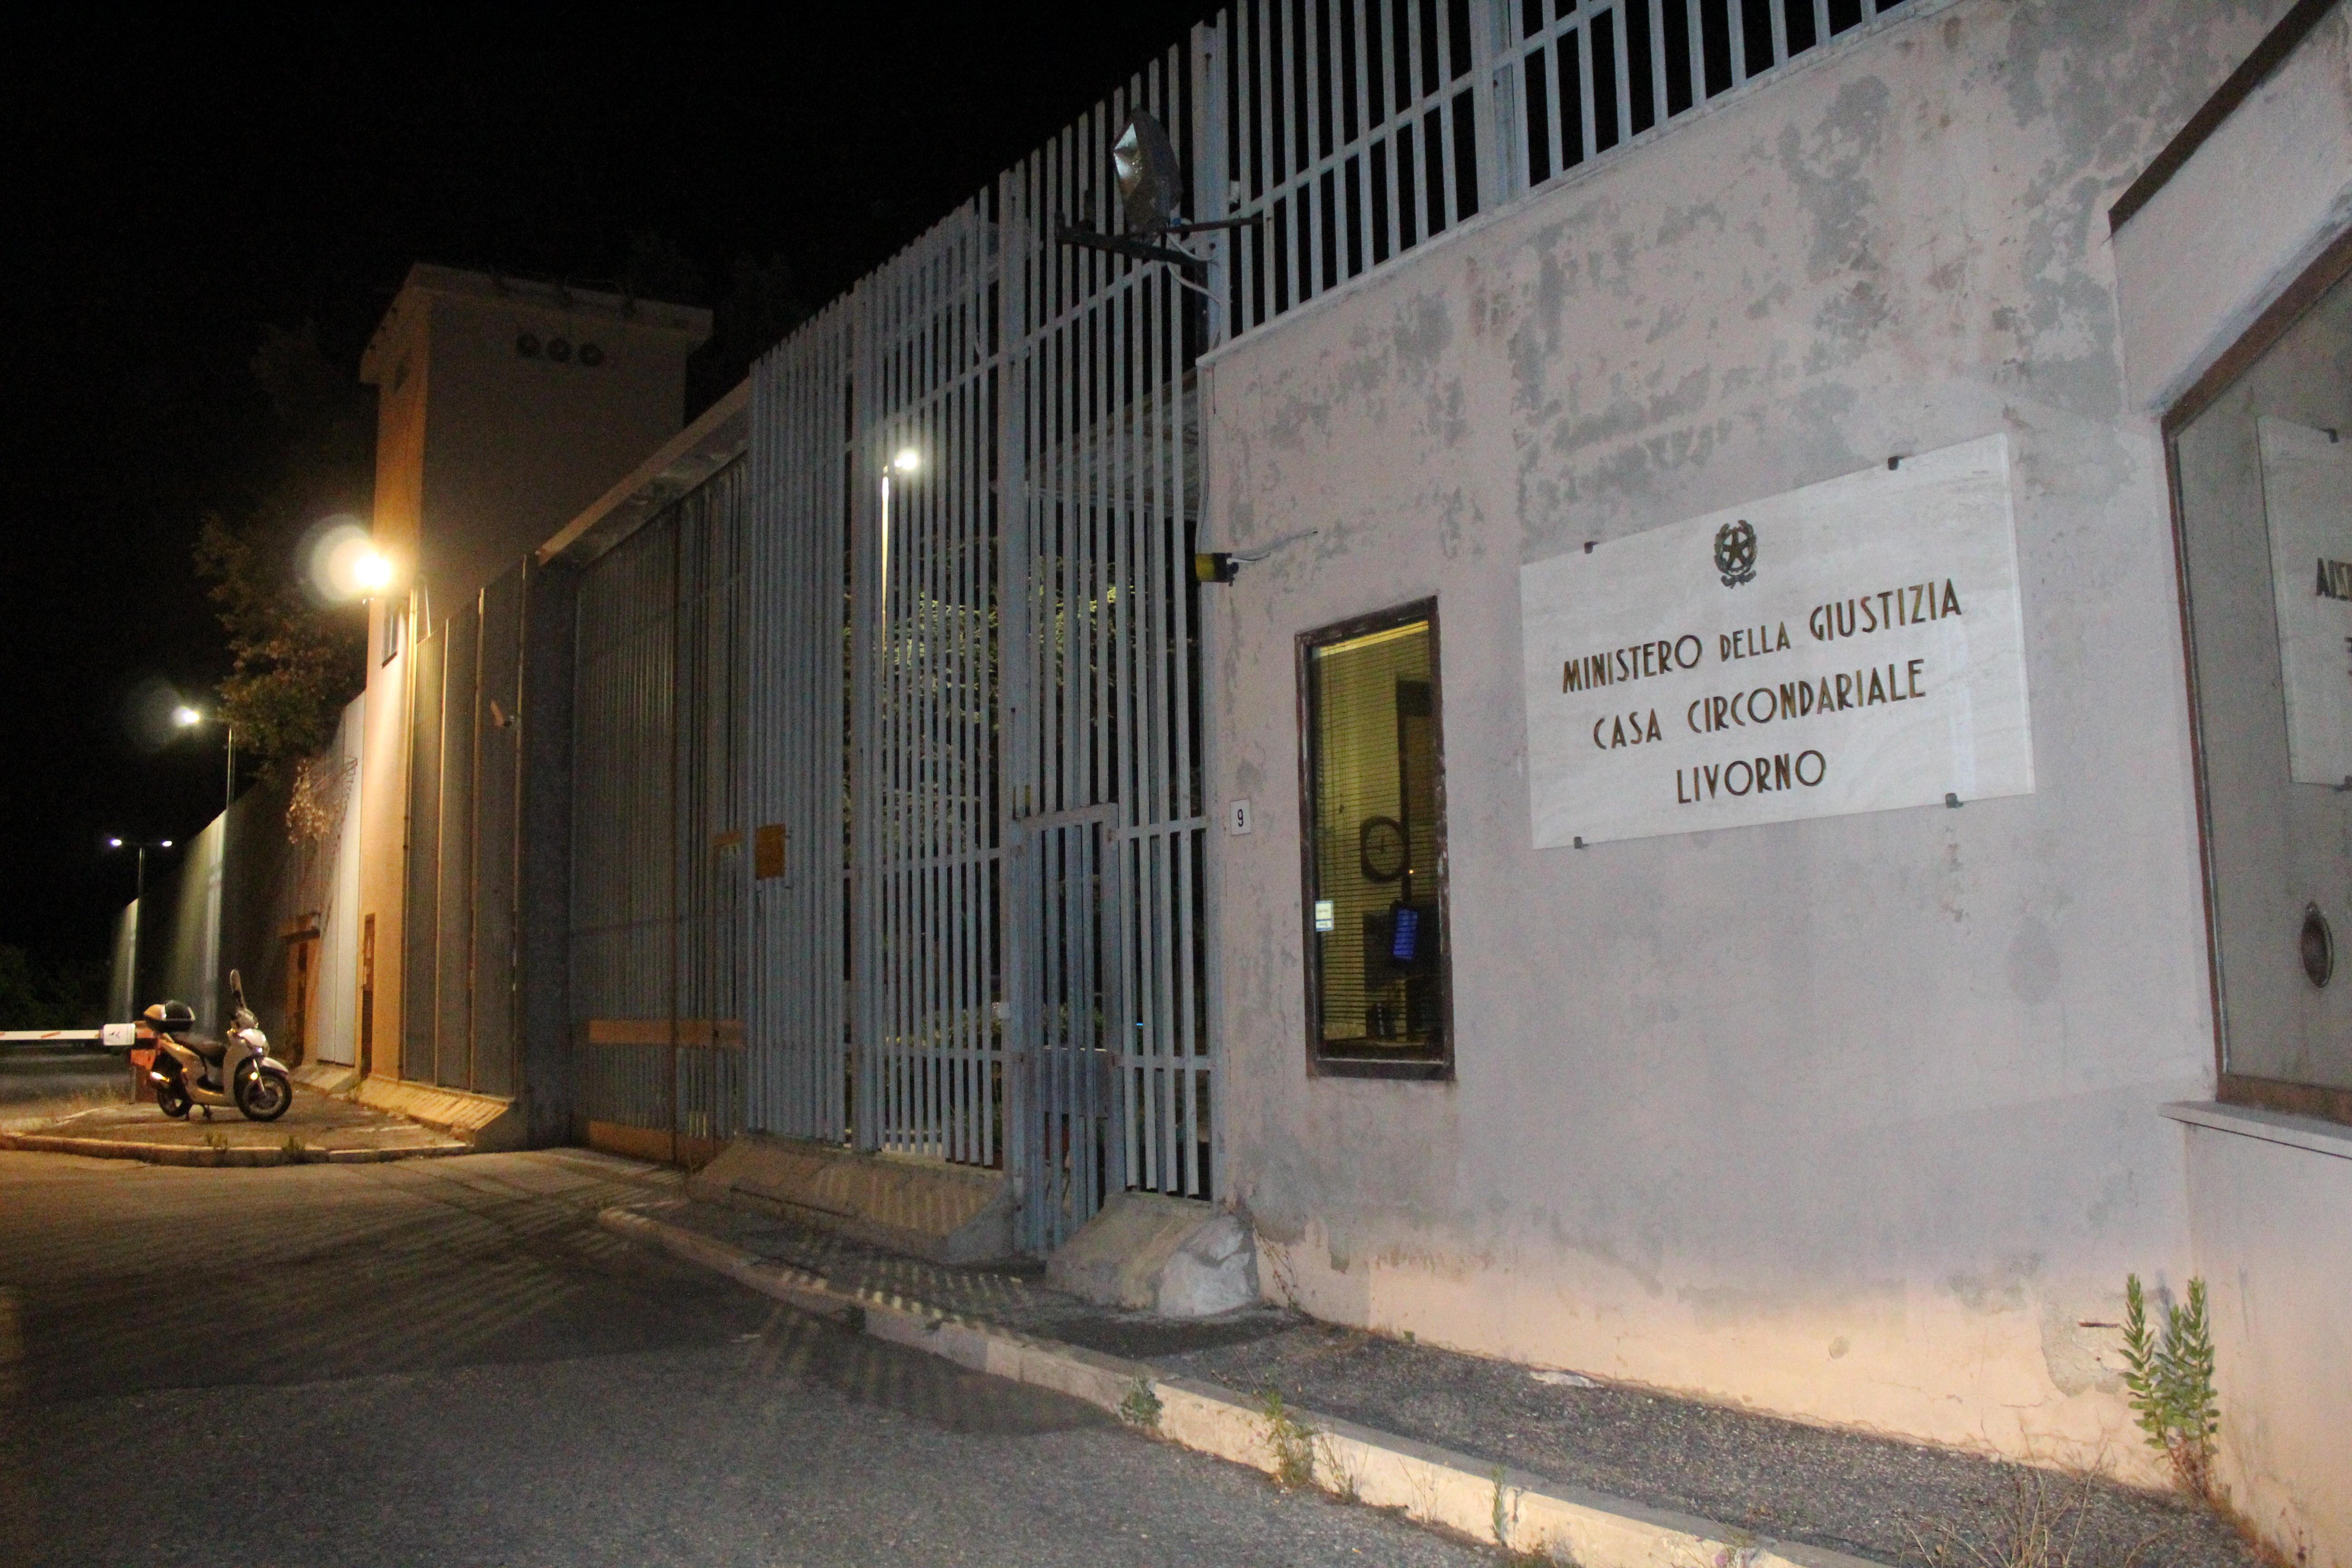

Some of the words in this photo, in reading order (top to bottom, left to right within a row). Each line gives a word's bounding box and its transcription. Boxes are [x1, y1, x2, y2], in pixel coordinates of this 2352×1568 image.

[1562, 633, 1703, 695] MINISTERO
[1719, 621, 1792, 663] DELLA
[1808, 578, 1963, 642] GIUSTIZIA
[1592, 708, 1663, 750] CASA
[1686, 658, 1926, 735] CIRCONDARIALE
[1676, 749, 1827, 805] LIVORNO
[1237, 808, 1244, 828] 9
